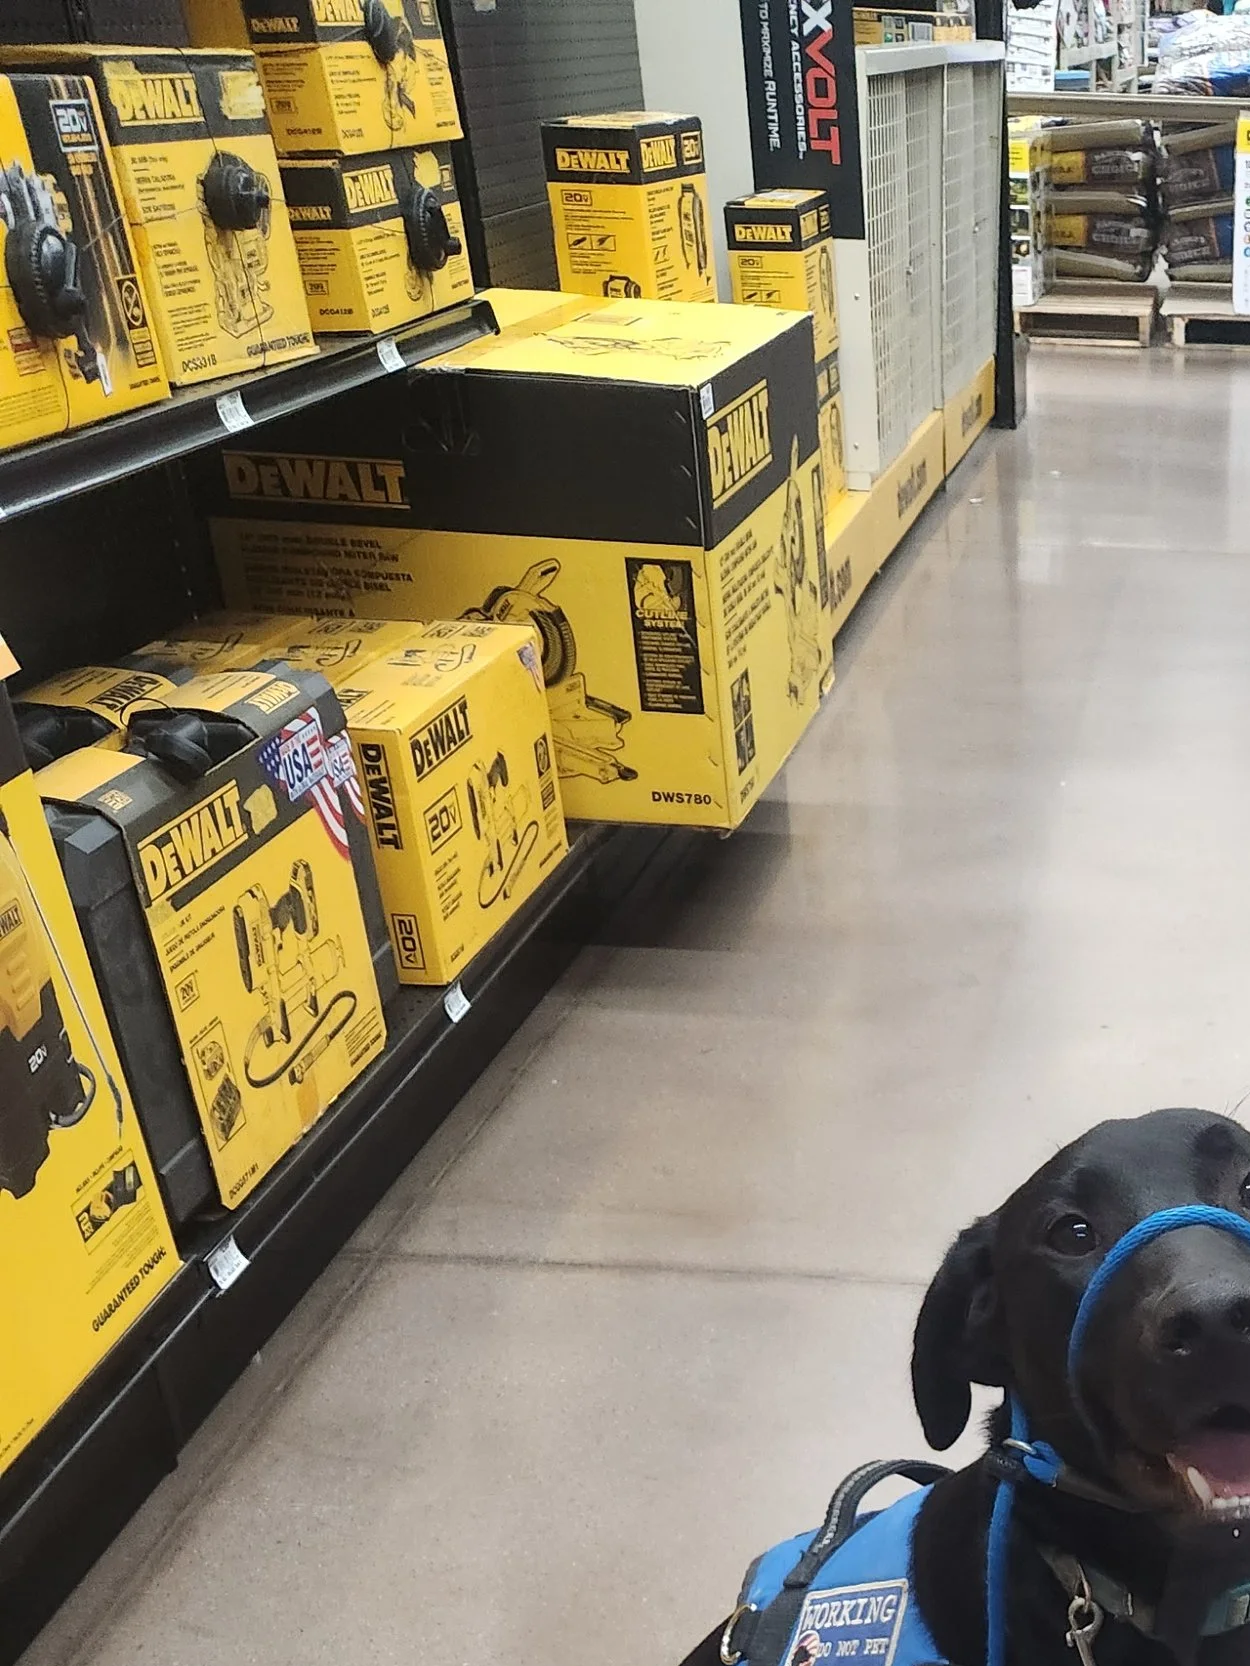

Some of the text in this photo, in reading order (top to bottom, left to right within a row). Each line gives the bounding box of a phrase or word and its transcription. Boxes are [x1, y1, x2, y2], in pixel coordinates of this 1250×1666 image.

[250, 17, 300, 33] DEWALT
[758, 2, 782, 152] TO MAXIMIZE RUNTIME.
[801, 0, 841, 165] XVOLT
[559, 151, 629, 170] DEWALT
[638, 138, 676, 167] DEWALT
[346, 170, 397, 209] DEWALT
[736, 225, 793, 240] DEWALT
[707, 387, 771, 502] DEWALT
[226, 453, 407, 505] DEWALT
[635, 607, 689, 620] CUTLINE
[643, 618, 686, 629] SYSTEM
[91, 674, 159, 712] DEWALT
[410, 702, 471, 778] DEWALT
[282, 742, 314, 789] USA
[360, 742, 399, 850] DEWALT
[651, 790, 713, 806] DWS780
[428, 801, 458, 842] 20V
[138, 789, 247, 898] DEWALT
[398, 918, 419, 965] 20V
[28, 1045, 48, 1074] 20V
[91, 1275, 141, 1332] GUARANTEED
[802, 1593, 898, 1631] WORKING
[816, 1636, 890, 1658] DO NOT PET
